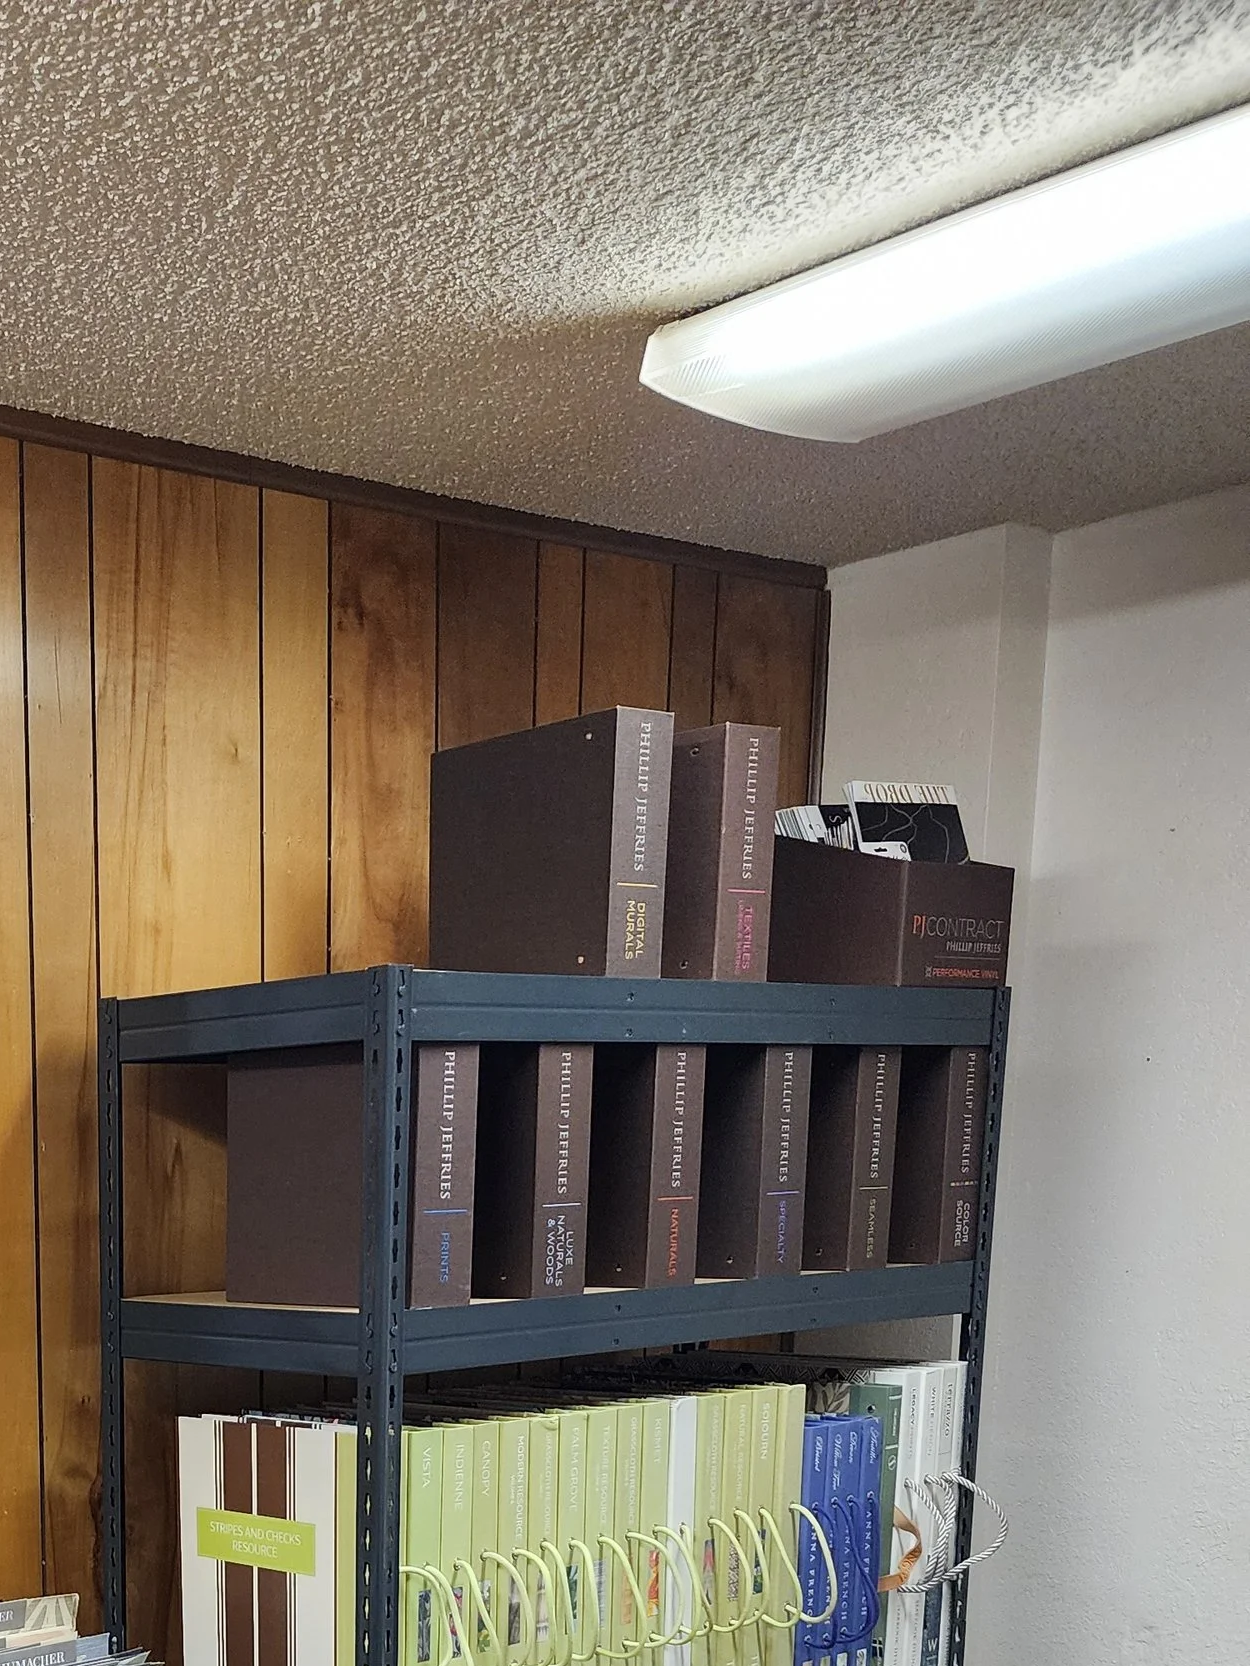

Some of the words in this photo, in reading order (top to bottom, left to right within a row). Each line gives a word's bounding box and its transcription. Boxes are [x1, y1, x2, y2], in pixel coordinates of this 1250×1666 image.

[637, 722, 652, 791] PHILLIP
[746, 738, 759, 803] PHILLIP
[634, 797, 647, 872] JEFFRIES
[742, 810, 755, 879] JEFFRIES
[624, 900, 636, 960] MURALS
[636, 902, 646, 958] DIGITAL
[742, 907, 753, 970] TEXTILES
[946, 941, 973, 952] PHILLIP
[973, 942, 1001, 954] JEFFRIES
[932, 967, 980, 978] PERFORMANCE
[443, 1051, 456, 1121] PHILLIP
[559, 1052, 572, 1118] PHILLIP
[675, 1051, 687, 1116] PHILLIP
[782, 1052, 794, 1113] PHILLIP
[875, 1054, 886, 1112] PHILLIP
[965, 1052, 976, 1109] PHILLIP
[439, 1126, 453, 1199] JEFFRIES
[557, 1124, 570, 1194] JEFFRIES
[672, 1120, 684, 1188] JEFFRIES
[779, 1118, 791, 1183] JEFFRIES
[870, 1116, 881, 1179] JEFFRIES
[961, 1114, 972, 1173] JEFFRIES
[547, 1218, 555, 1228] &
[555, 1215, 565, 1287] NATURALS
[565, 1231, 574, 1265] LUXE
[668, 1208, 679, 1277] NATURALS
[777, 1200, 787, 1264] SPECIALTY
[866, 1198, 876, 1259] SEAMLESS
[954, 1200, 963, 1247] SOURCE
[962, 1202, 970, 1243] COLOR
[440, 1232, 450, 1284] PRINTS
[545, 1232, 555, 1285] WOODS
[570, 1428, 579, 1464] PALM
[761, 1402, 770, 1459] SOJOURN
[422, 1447, 431, 1488] VISTA
[454, 1443, 464, 1511] INDIENNE
[481, 1440, 491, 1496] CANOPY
[516, 1435, 525, 1486] MODERN
[569, 1467, 579, 1512] GROVE
[210, 1521, 243, 1537] STRIPES
[245, 1527, 264, 1540] AND
[266, 1529, 301, 1546] CHECKS
[515, 1487, 524, 1542] RESOURCE
[232, 1540, 278, 1558] RESOURCE
[841, 1561, 850, 1619] FRENCH
